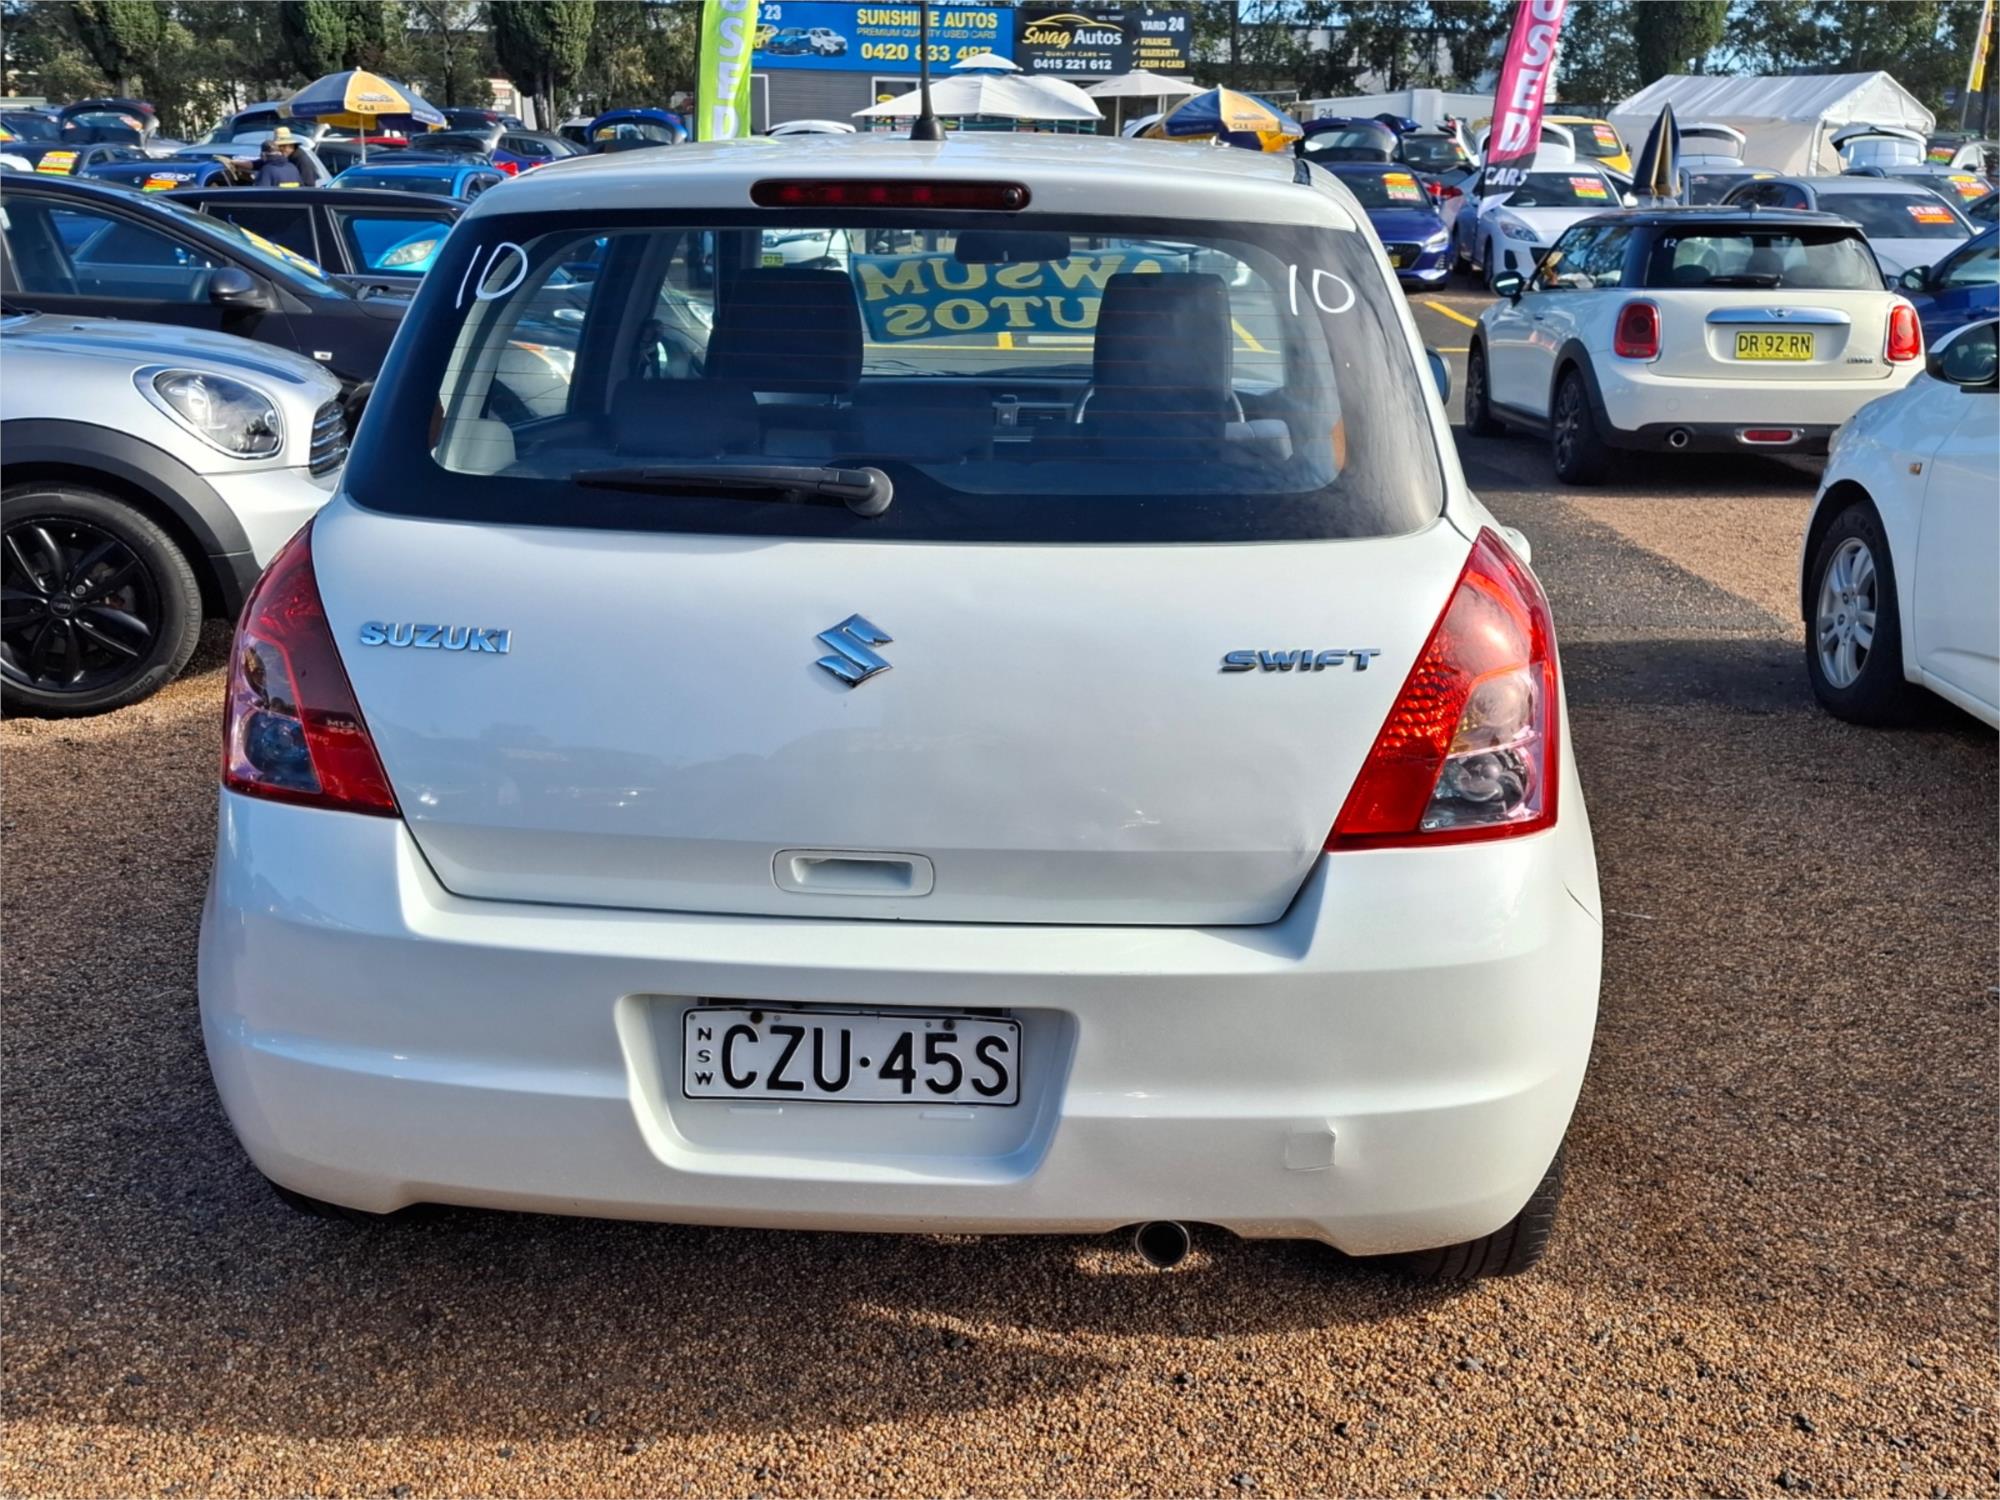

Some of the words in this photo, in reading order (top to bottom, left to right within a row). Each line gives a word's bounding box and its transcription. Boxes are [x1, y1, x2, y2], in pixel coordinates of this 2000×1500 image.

[764, 4, 782, 20] 23
[857, 8, 940, 27] SUNSHIE
[944, 11, 998, 29] AUTOS
[857, 26, 899, 37] PREMIUM
[901, 28, 940, 38] QUAITY
[943, 29, 969, 39] USED
[970, 30, 997, 40] CARS
[1140, 20, 1167, 31] YARD
[1168, 16, 1185, 31] 24
[1022, 27, 1072, 49] Swag
[1073, 29, 1122, 45] Autos
[861, 42, 909, 60] 0420
[1033, 58, 1063, 70] 0415
[1065, 59, 1087, 70] 221
[1089, 59, 1113, 70] 612
[1484, 166, 1528, 187] CARS
[455, 241, 528, 310] 10
[1288, 264, 1356, 316] 10
[359, 619, 513, 655] SUZUKI
[1218, 648, 1382, 673] SWIFT
